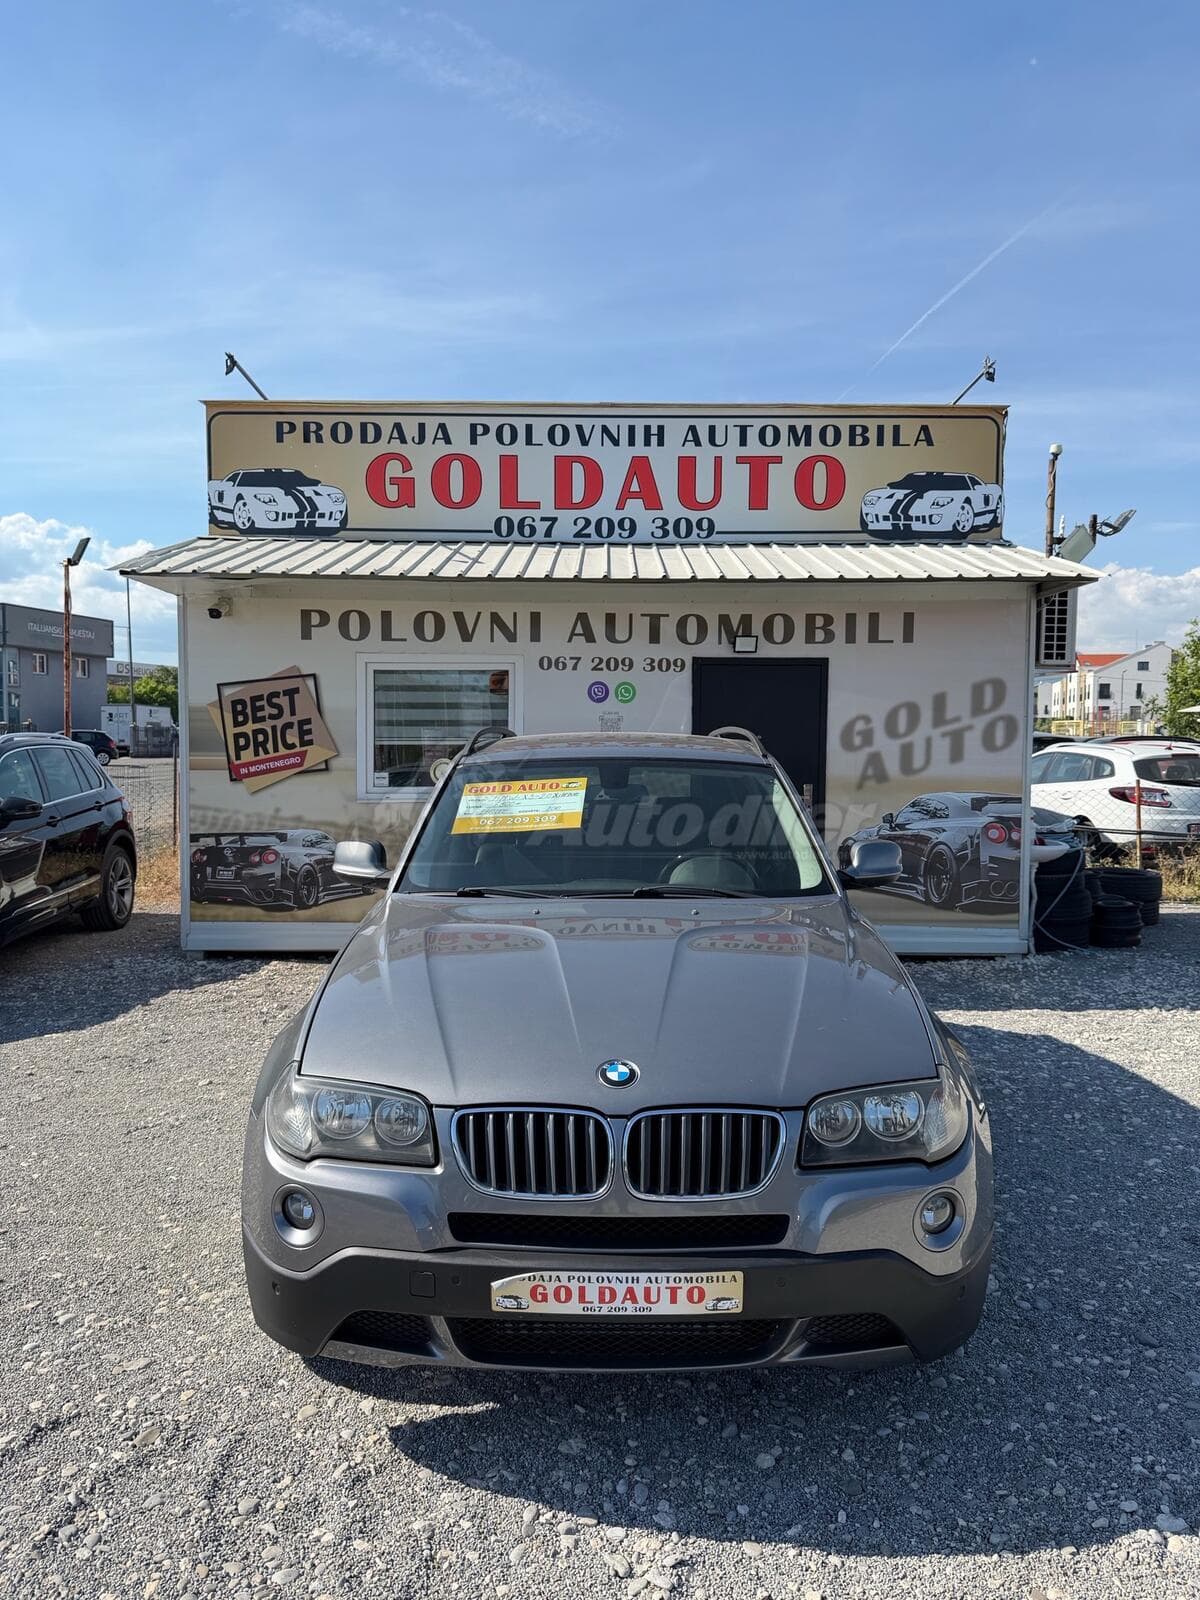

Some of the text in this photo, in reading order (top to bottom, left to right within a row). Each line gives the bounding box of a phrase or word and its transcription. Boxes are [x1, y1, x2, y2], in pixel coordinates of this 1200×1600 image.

[276, 421, 935, 447] PRODAJA POLOVNIH AUTOMOBILA
[365, 452, 846, 511] GOLDAUTO
[493, 516, 716, 539] 067 209 309
[300, 608, 915, 645] POLOVNI AUTOMOBILI
[538, 656, 687, 673] 067 209 309
[231, 687, 300, 728] BEST
[840, 677, 1007, 753] GOLD
[233, 718, 314, 761] PRICE
[857, 714, 1018, 790] AUTO
[240, 756, 301, 775] IN MONTENEGRO
[468, 782, 560, 793] GOLD AUTO
[567, 1275, 640, 1284] POLOVNIH
[645, 1275, 738, 1284] AUTOMOBILA
[529, 1284, 706, 1304] GOLDAUTO
[582, 1305, 603, 1313] 067
[607, 1305, 628, 1313] 209
